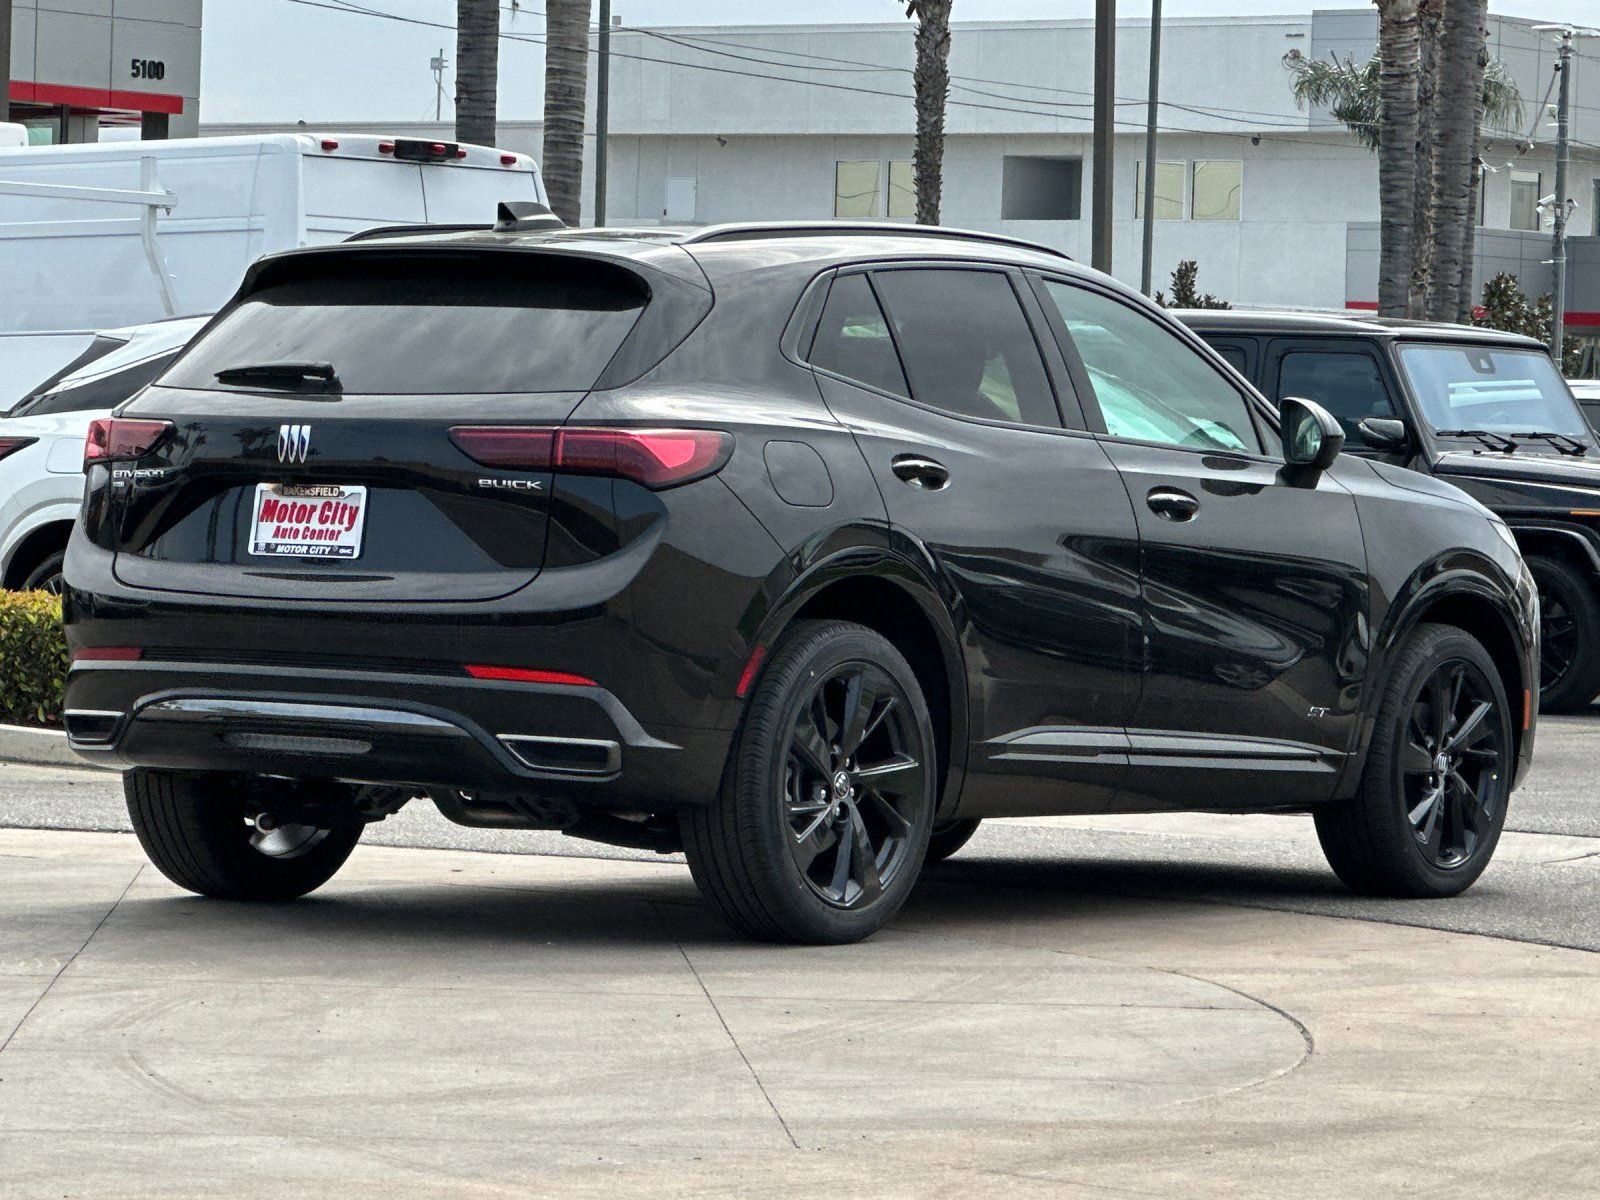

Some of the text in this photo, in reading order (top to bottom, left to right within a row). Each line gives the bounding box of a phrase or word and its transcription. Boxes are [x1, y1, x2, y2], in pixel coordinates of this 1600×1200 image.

[131, 59, 164, 80] 5100
[283, 486, 339, 496] BAKERSFIELD
[478, 479, 543, 490] BUICK
[260, 499, 359, 532] Motor City
[272, 525, 342, 541] Auto Center
[276, 544, 307, 554] MOTOR
[309, 545, 331, 555] CITY
